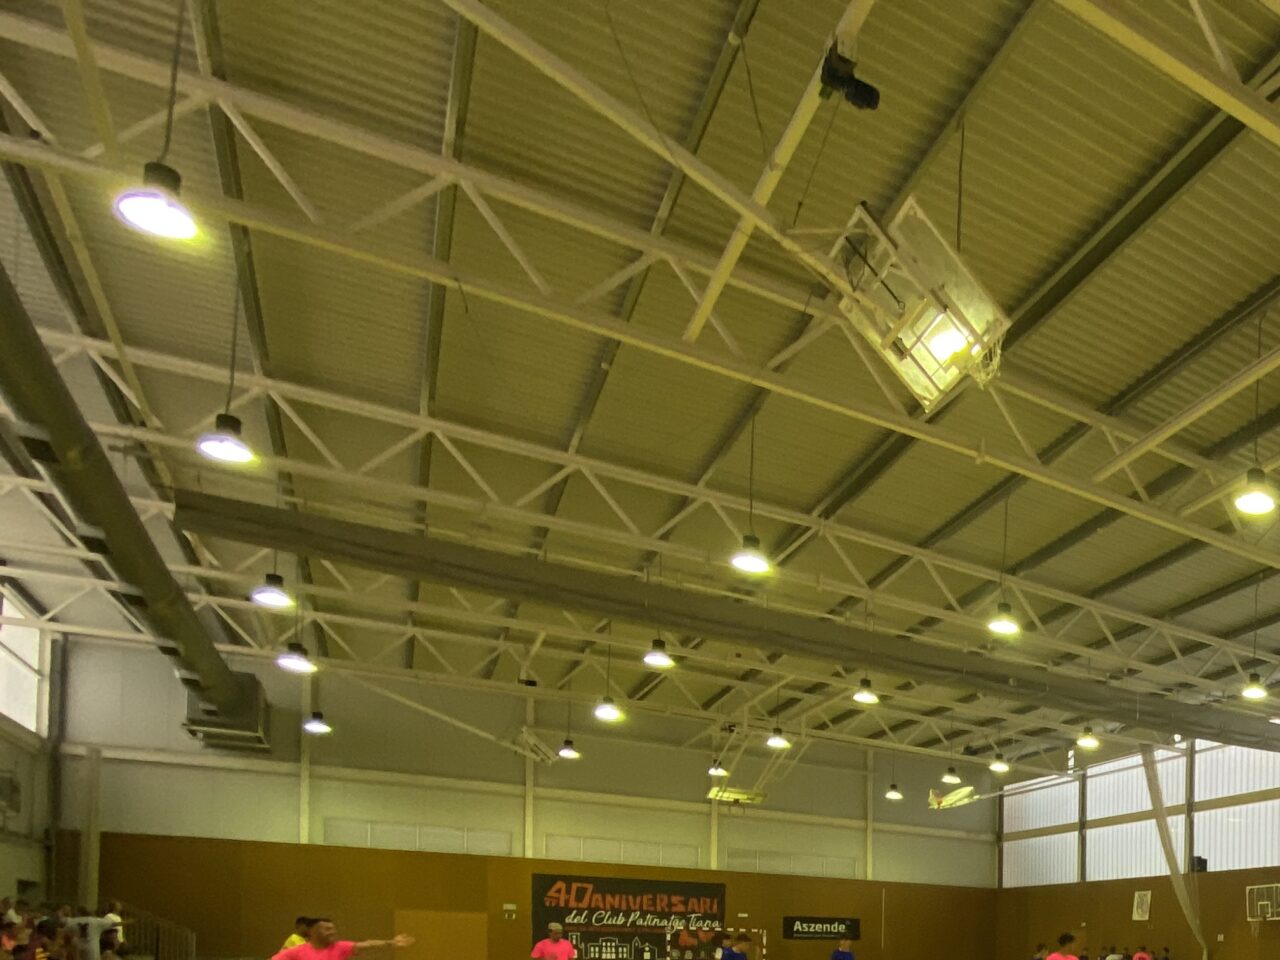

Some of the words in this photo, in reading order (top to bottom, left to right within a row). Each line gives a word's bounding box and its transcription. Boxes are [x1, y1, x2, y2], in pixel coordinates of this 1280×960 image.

[591, 893, 718, 913] ANIVERSARI
[565, 910, 588, 924] del
[592, 911, 626, 926] Club
[686, 913, 721, 928] Tiana
[793, 920, 846, 933] Aszende
